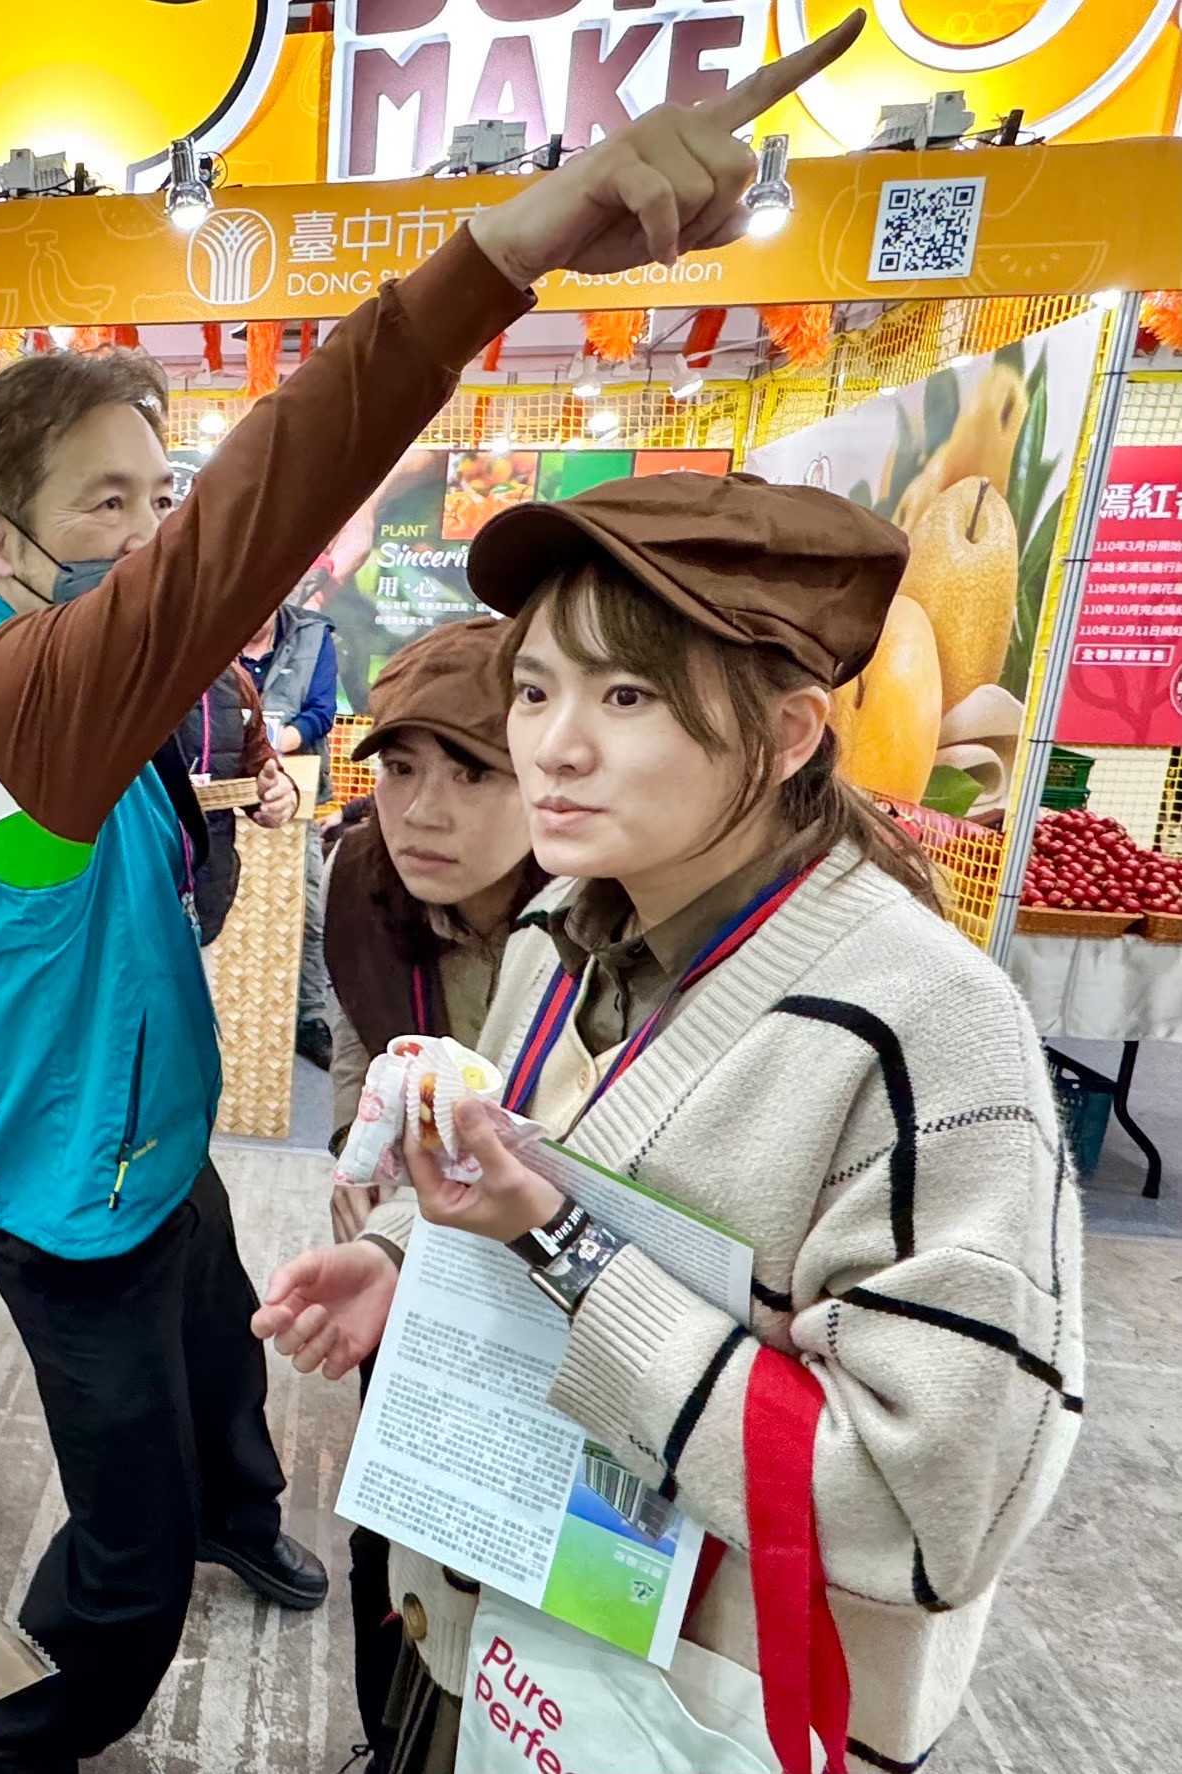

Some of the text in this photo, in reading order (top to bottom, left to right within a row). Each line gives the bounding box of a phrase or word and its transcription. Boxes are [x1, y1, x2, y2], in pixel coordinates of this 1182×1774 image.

[348, 15, 743, 176] MAKE
[287, 271, 373, 297] DONG
[378, 541, 470, 568] Sinceri
[380, 524, 428, 537] PLANT
[482, 1636, 562, 1731] Pure
[475, 1671, 576, 1774] Perfe
